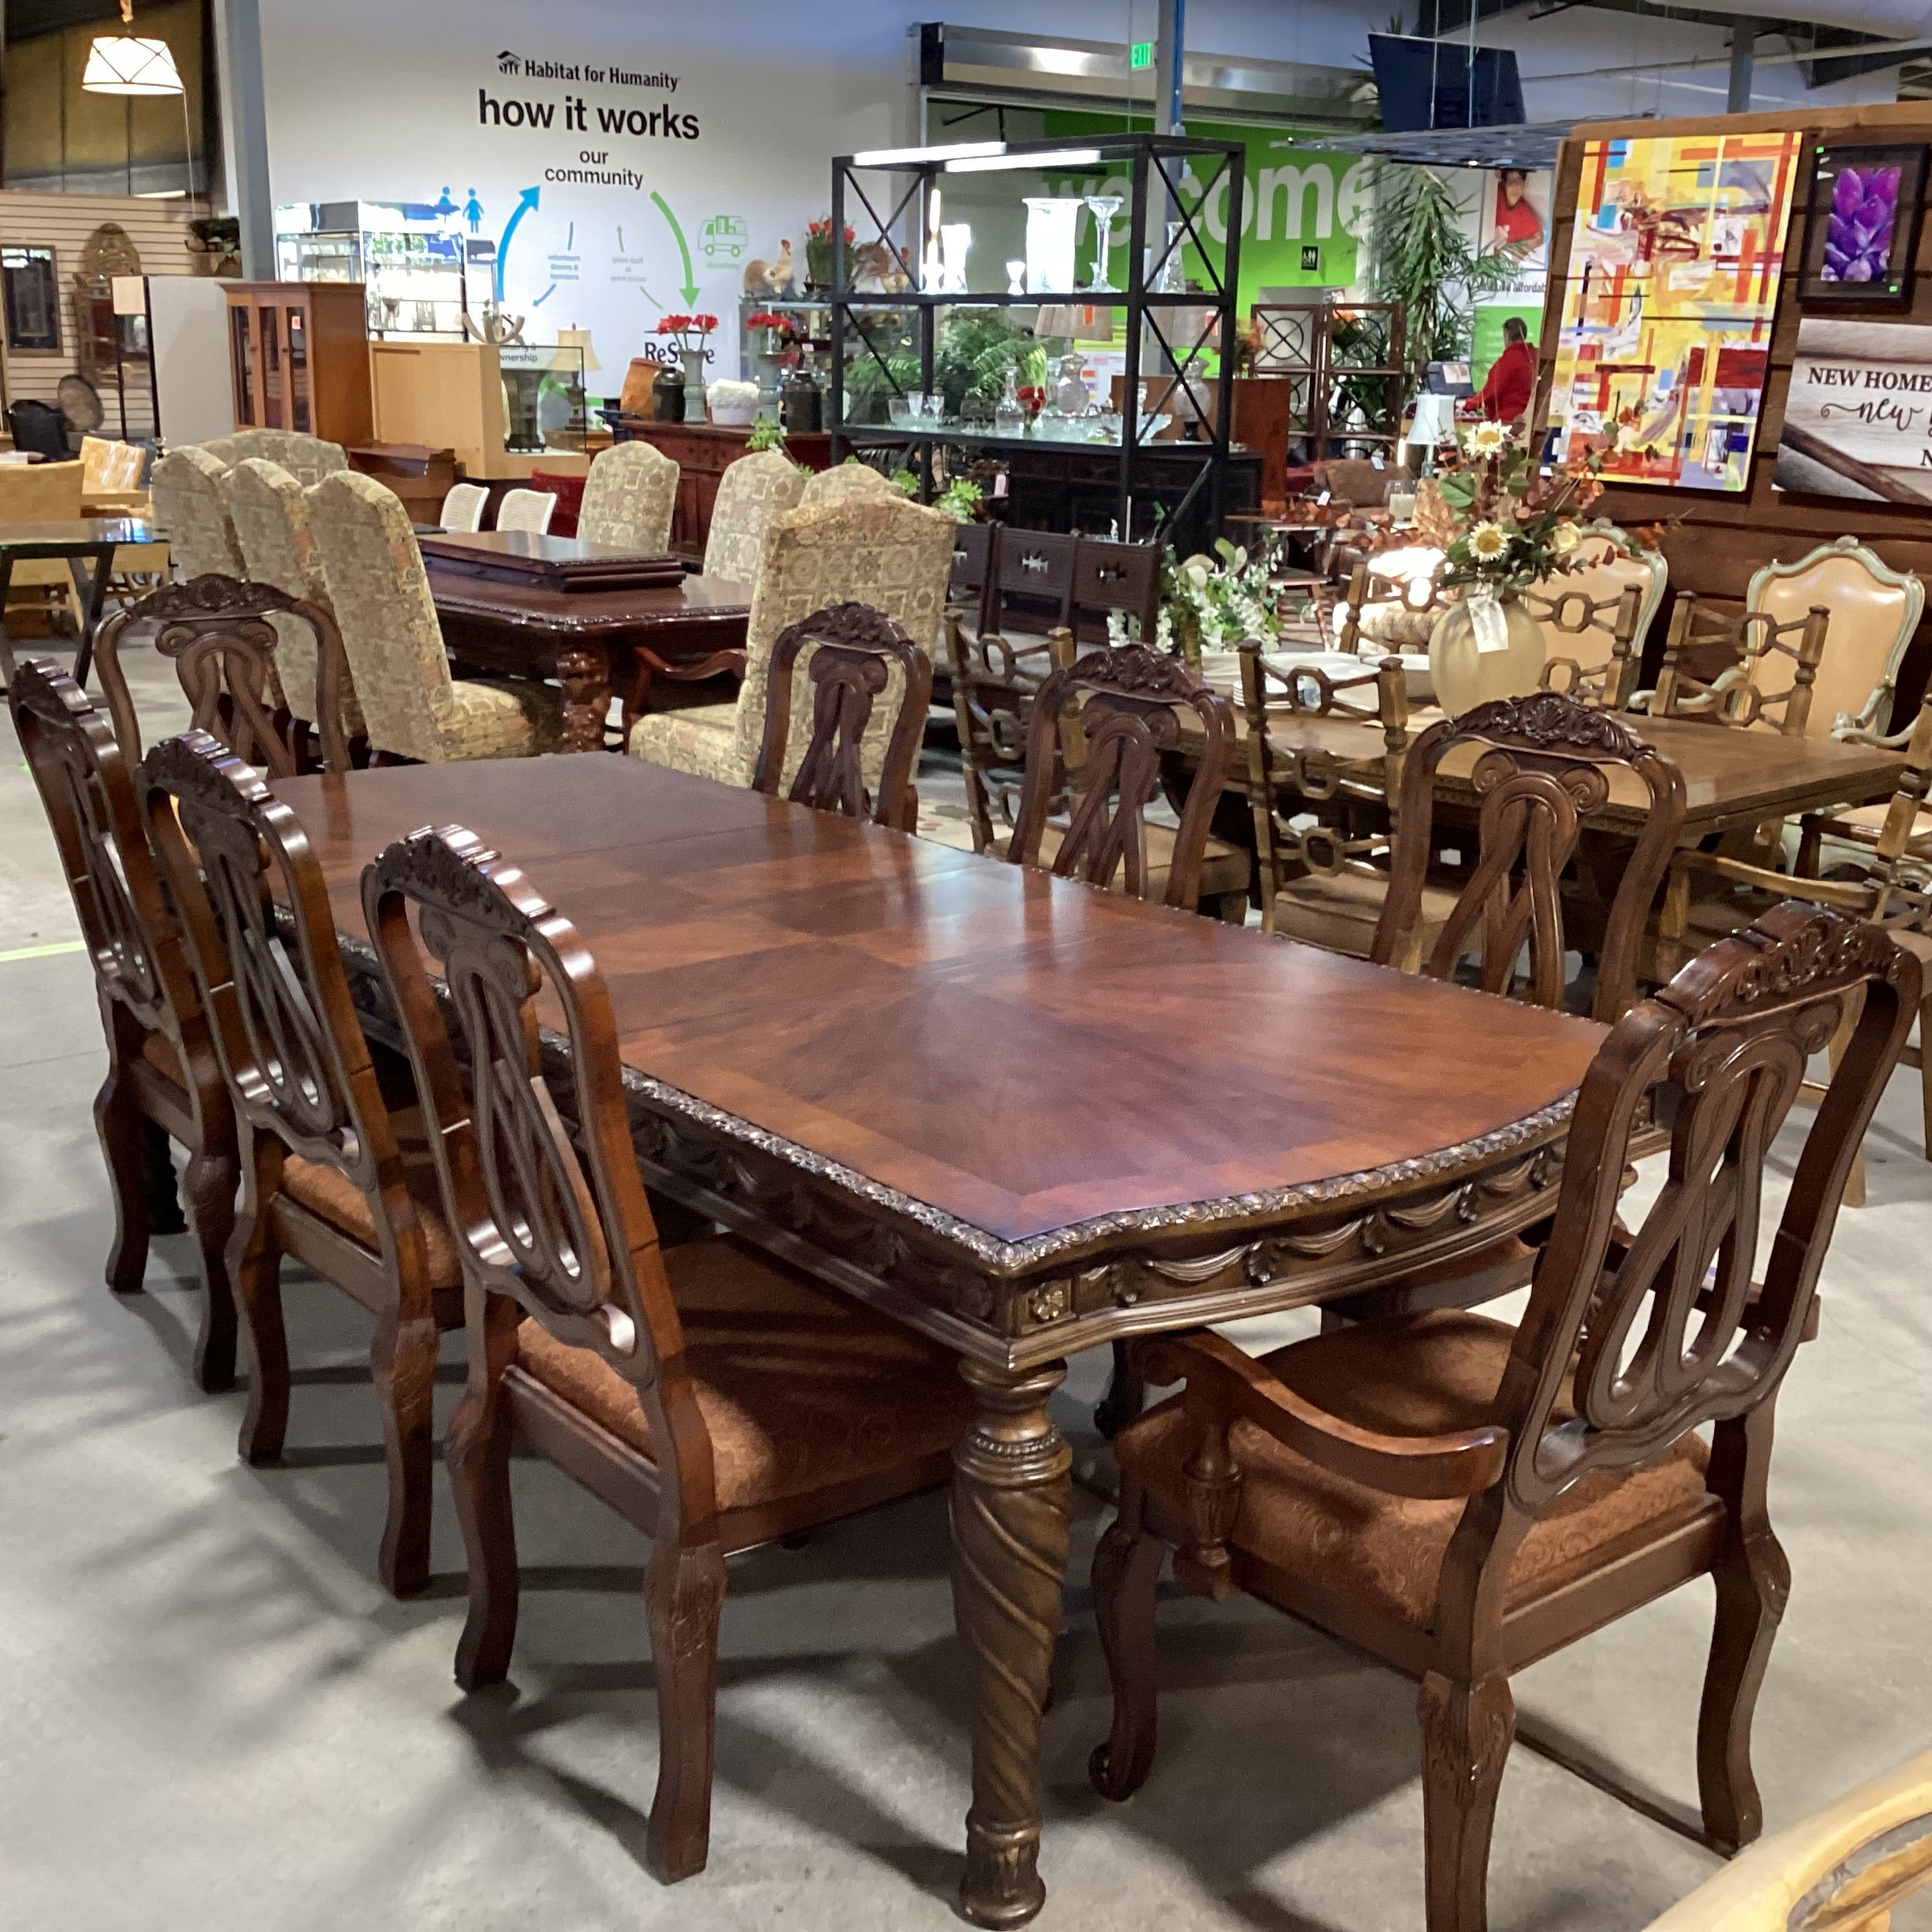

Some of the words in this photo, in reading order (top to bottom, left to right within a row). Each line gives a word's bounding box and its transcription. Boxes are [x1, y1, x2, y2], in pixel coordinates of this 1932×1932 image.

[1132, 43, 1151, 68] EXIT
[525, 59, 580, 80] Habitat
[585, 65, 605, 83] for
[609, 66, 679, 92] Humanity
[478, 88, 555, 129] how
[565, 95, 587, 132] it
[597, 103, 700, 140] works
[579, 150, 608, 164] our
[545, 168, 643, 190] community
[1040, 162, 1365, 247] ecome
[644, 342, 715, 364] ReSe
[1807, 367, 1860, 388] NEW
[1821, 398, 1923, 432] new
